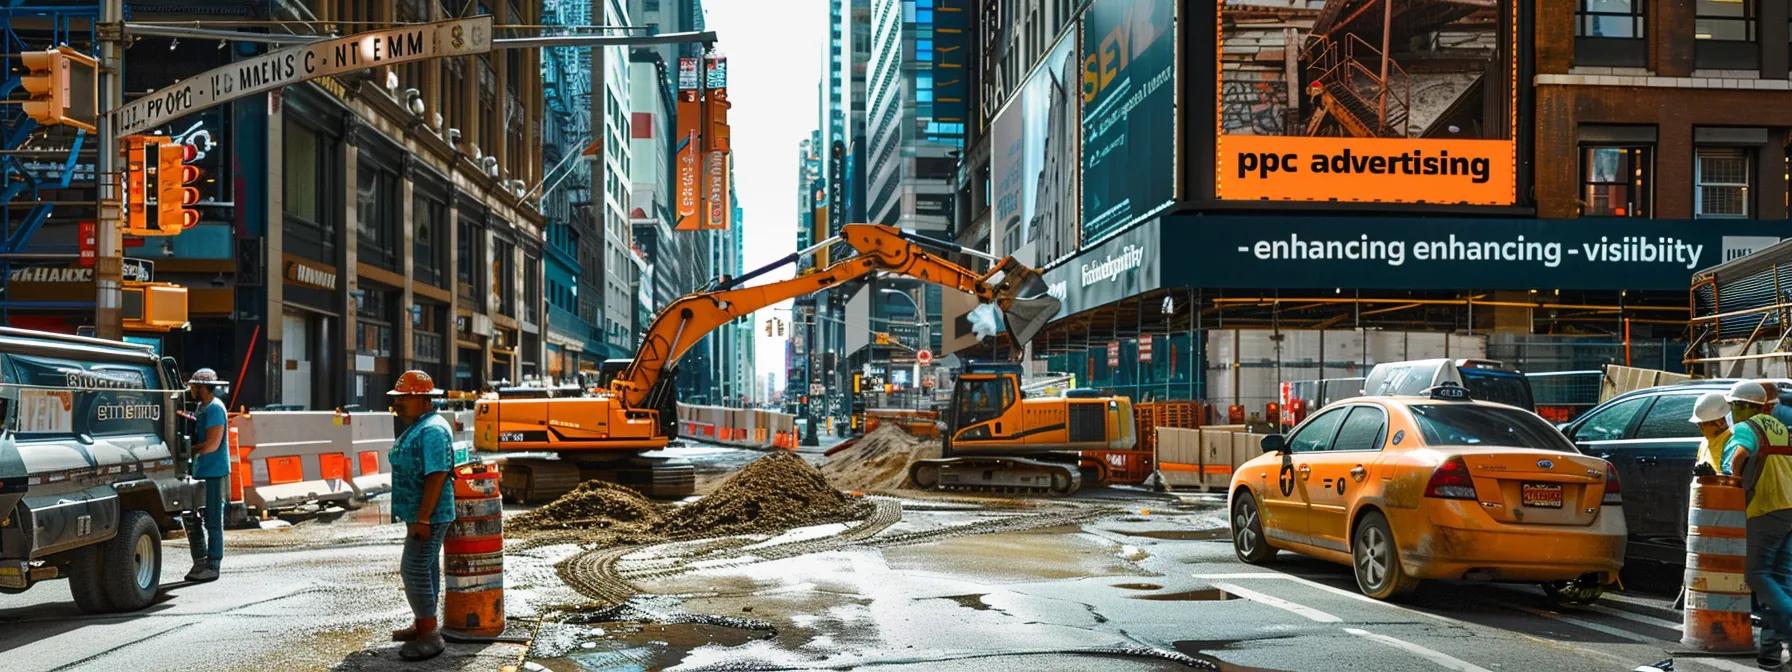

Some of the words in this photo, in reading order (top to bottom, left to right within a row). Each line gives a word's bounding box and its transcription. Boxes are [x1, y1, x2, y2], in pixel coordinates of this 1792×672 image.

[1237, 152, 1298, 179] ppc
[1310, 149, 1490, 184] advertising
[1413, 234, 1562, 268] enhancing
